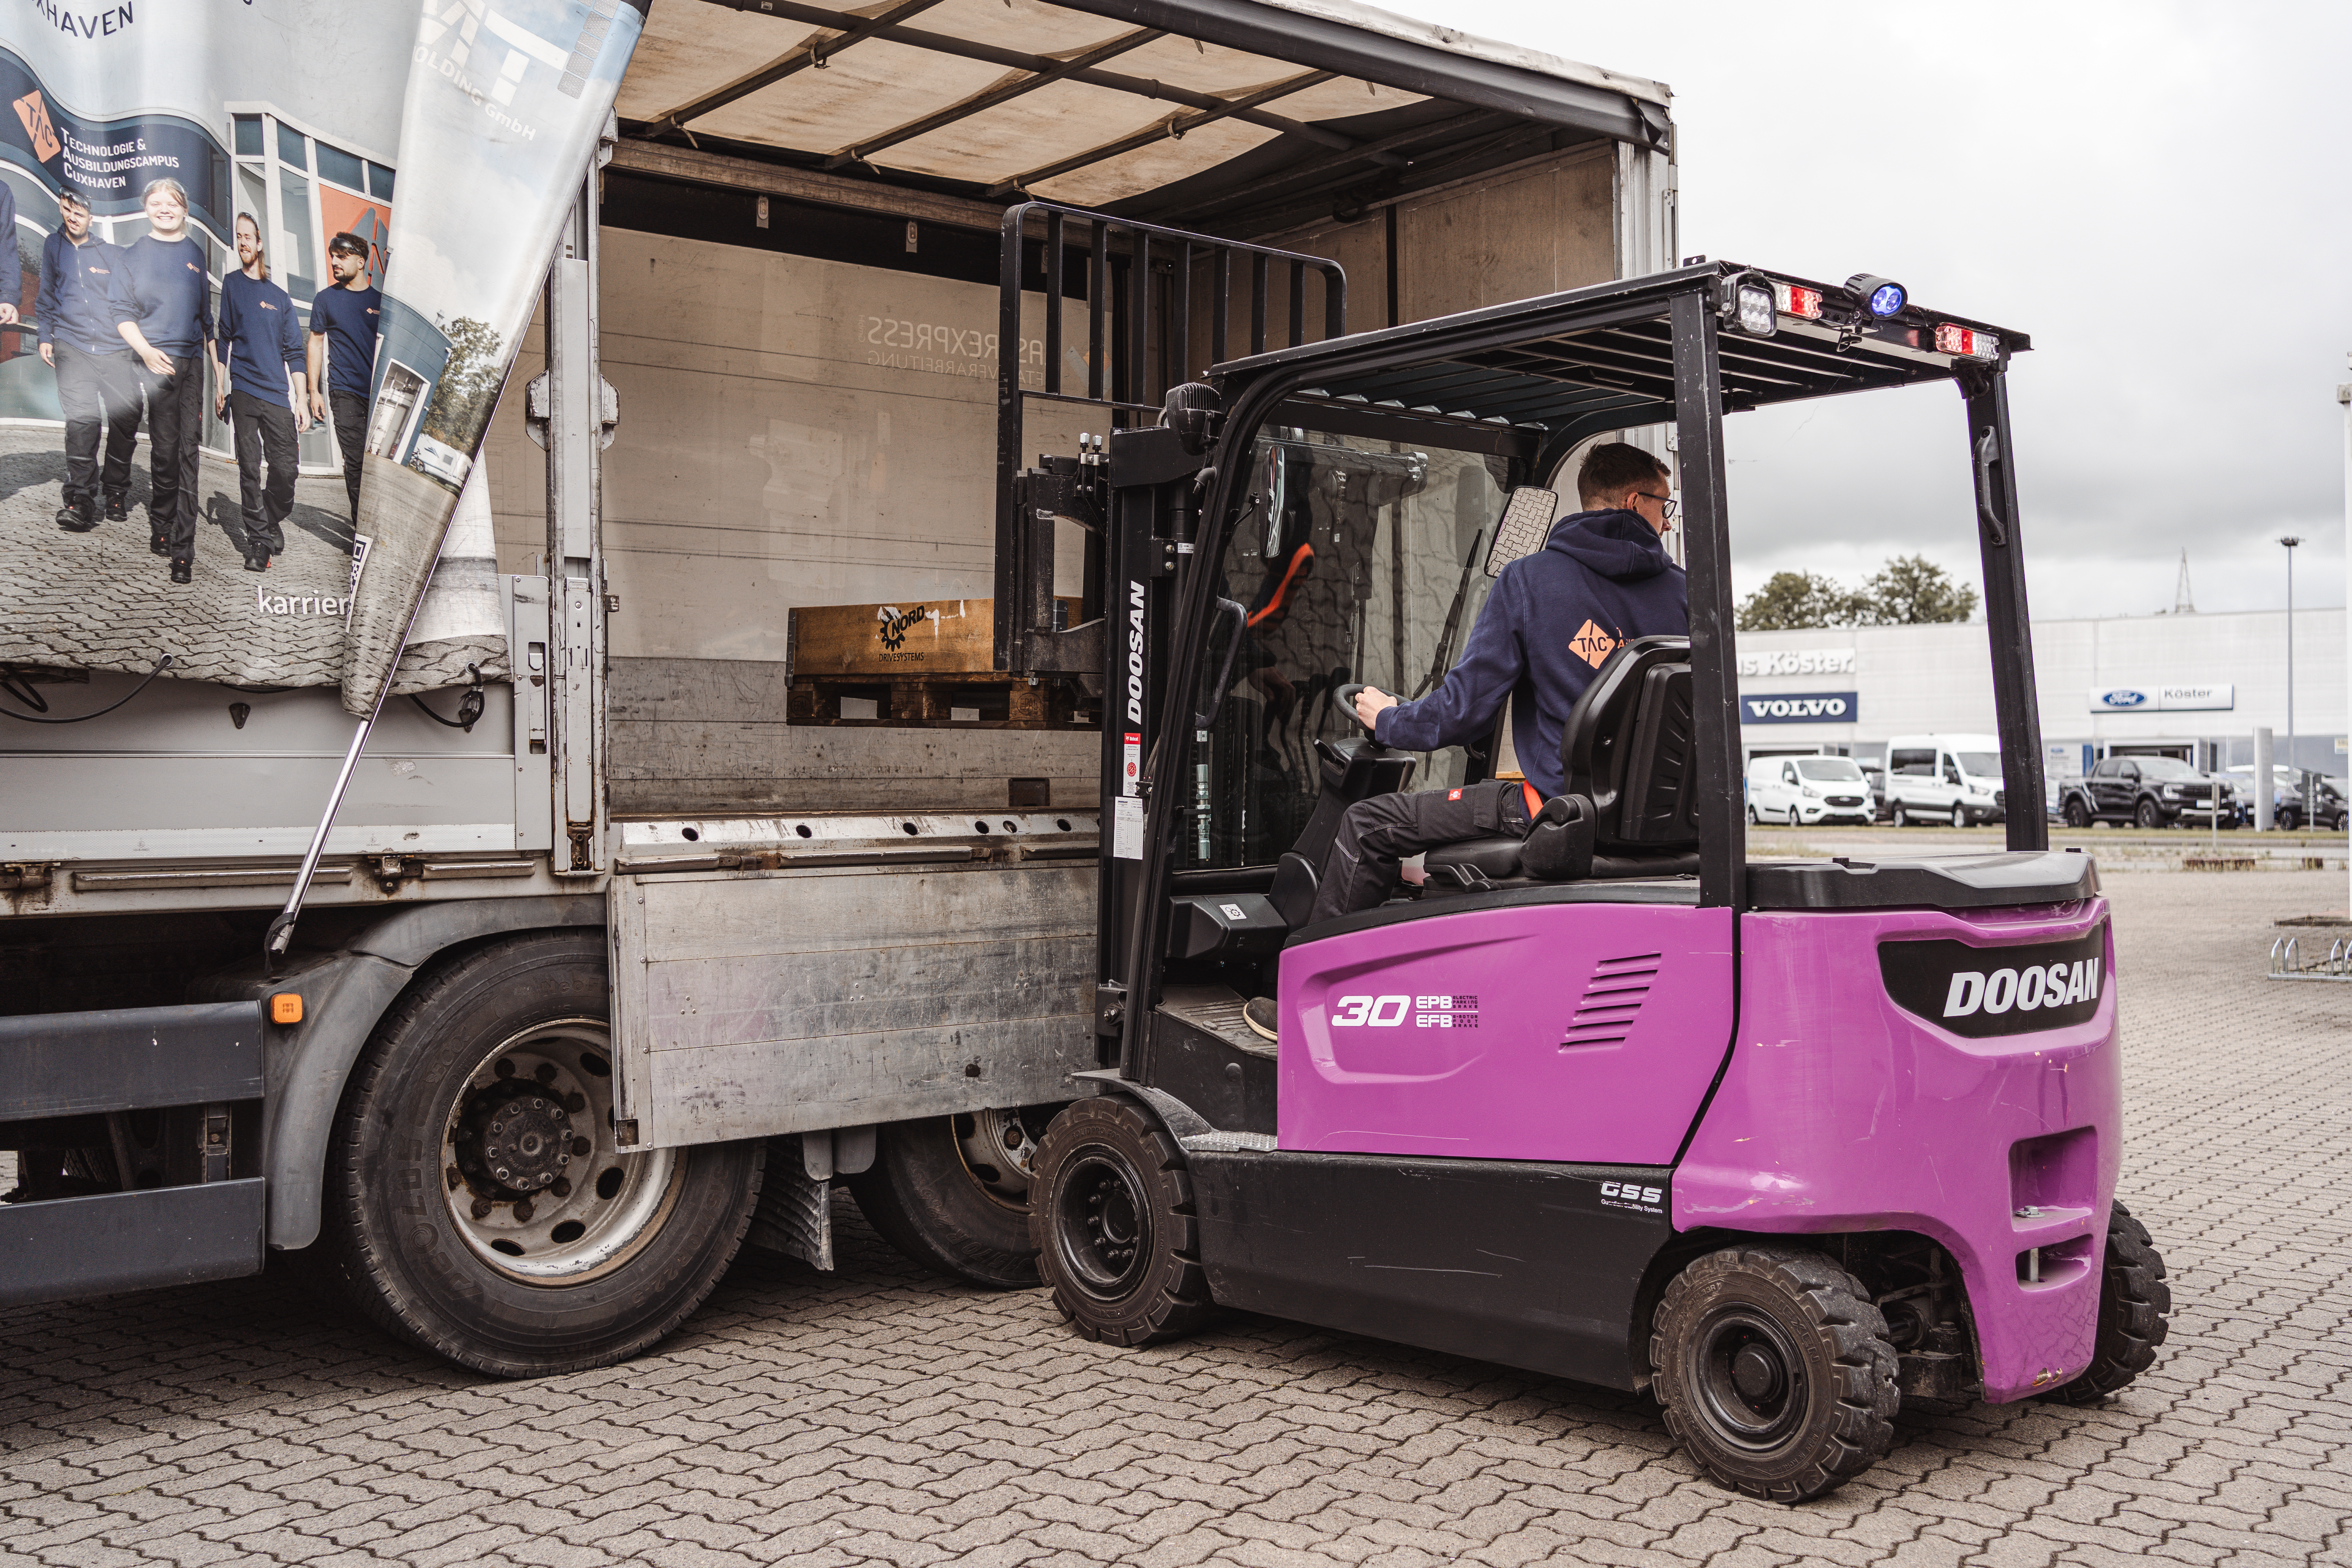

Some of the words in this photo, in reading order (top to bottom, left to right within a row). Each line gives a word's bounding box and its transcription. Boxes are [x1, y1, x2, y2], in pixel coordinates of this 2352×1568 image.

[413, 45, 483, 107] OLDING
[485, 103, 537, 141] GmbH
[60, 127, 135, 157] TECHNOLOGIE
[136, 138, 147, 151] &
[63, 145, 180, 173] AUSBILDUNGSCAMPUS
[64, 162, 126, 189] CUXHAVEN
[258, 585, 349, 615] karrier
[892, 605, 925, 637] NORD
[879, 652, 924, 662] DRIVESYSTEMS
[1128, 581, 1144, 725] DOOSAN
[1577, 637, 1607, 652] TAC
[1766, 651, 1854, 675] Köster
[2164, 687, 2212, 699] Köster
[1747, 698, 1847, 717] VOLVO
[1943, 957, 2099, 1017] DOOSAN
[1331, 995, 1411, 1027] 30
[1416, 995, 1453, 1009] EPB
[1416, 1014, 1453, 1028] EFB
[1072, 1126, 1105, 1140] SOLIDPRO
[1107, 1129, 1120, 1142] 700
[1601, 1181, 1662, 1203] GSS
[1087, 1304, 1126, 1318] NEXEN
[1770, 1294, 1820, 1363] NEXEN
